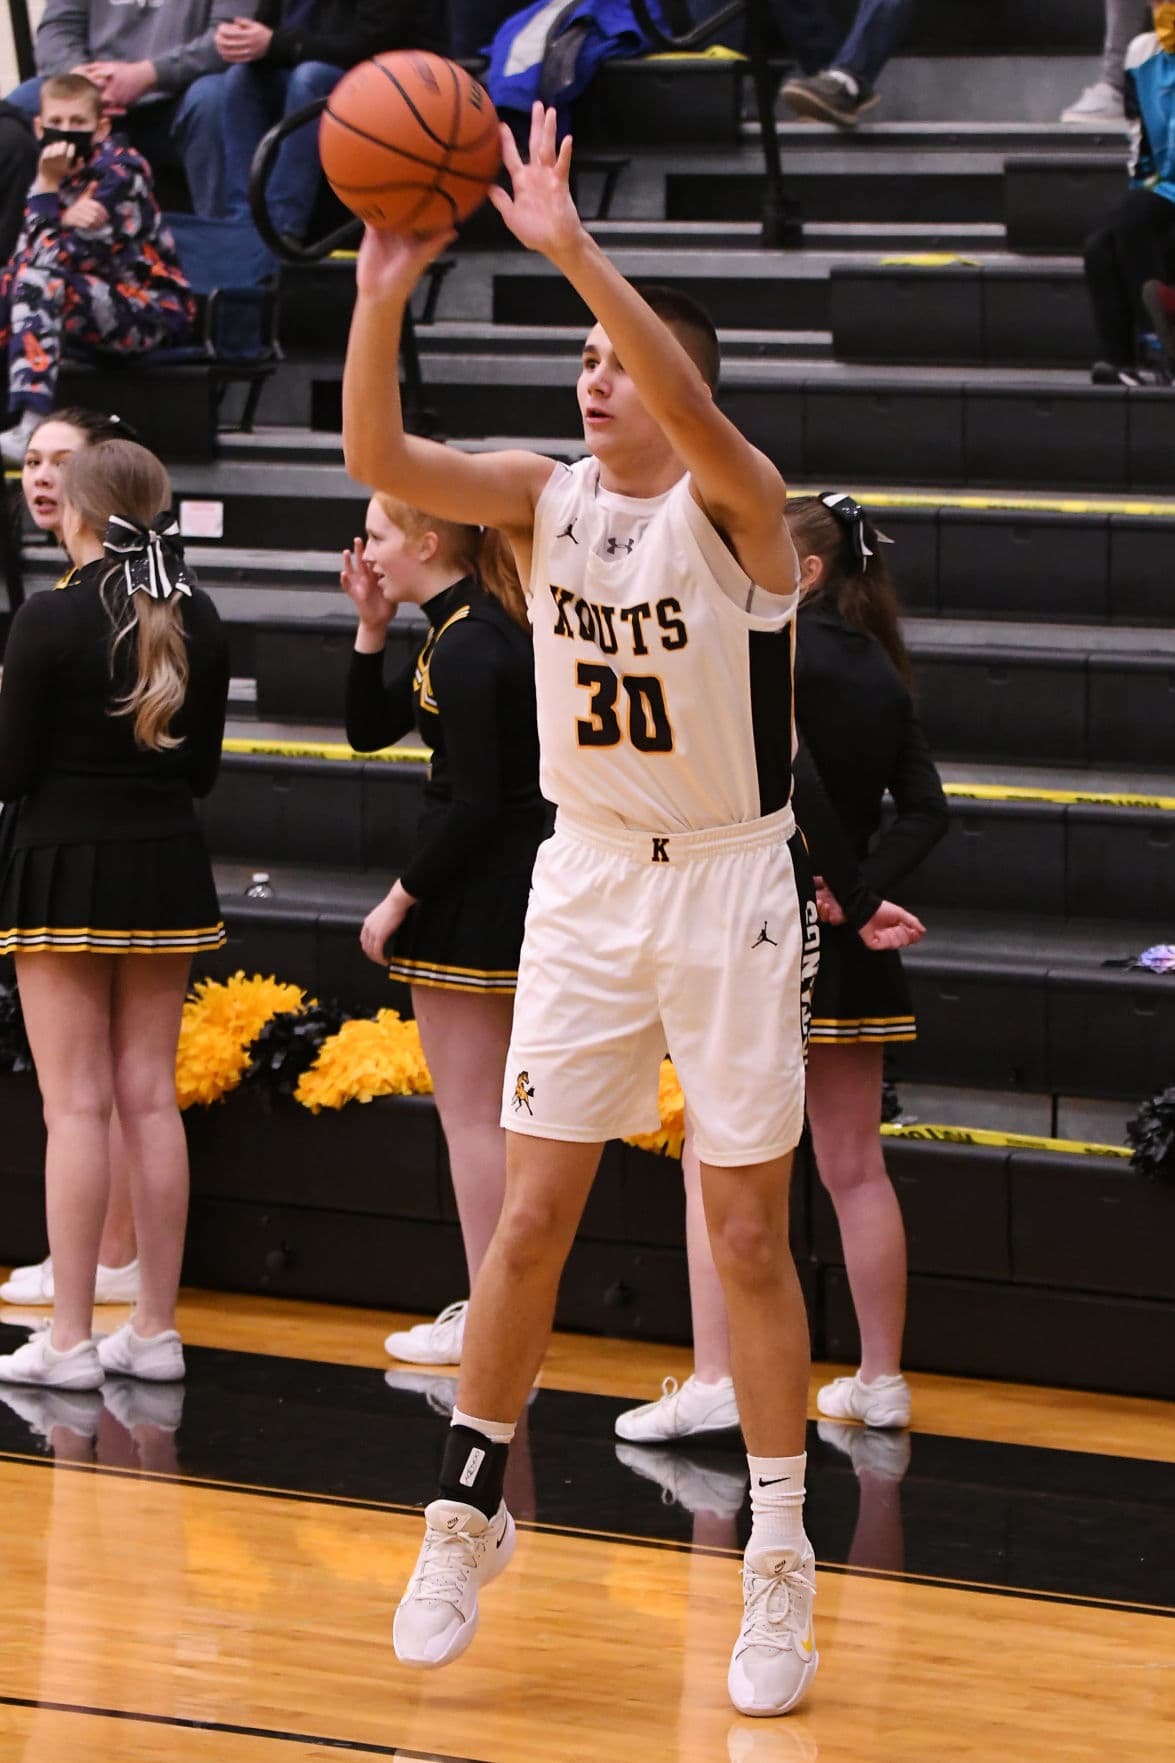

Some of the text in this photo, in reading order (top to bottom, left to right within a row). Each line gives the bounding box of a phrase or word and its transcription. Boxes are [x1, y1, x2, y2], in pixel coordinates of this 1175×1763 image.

[549, 584, 688, 656] KOUTS
[574, 658, 674, 754] 30
[651, 838, 670, 862] K
